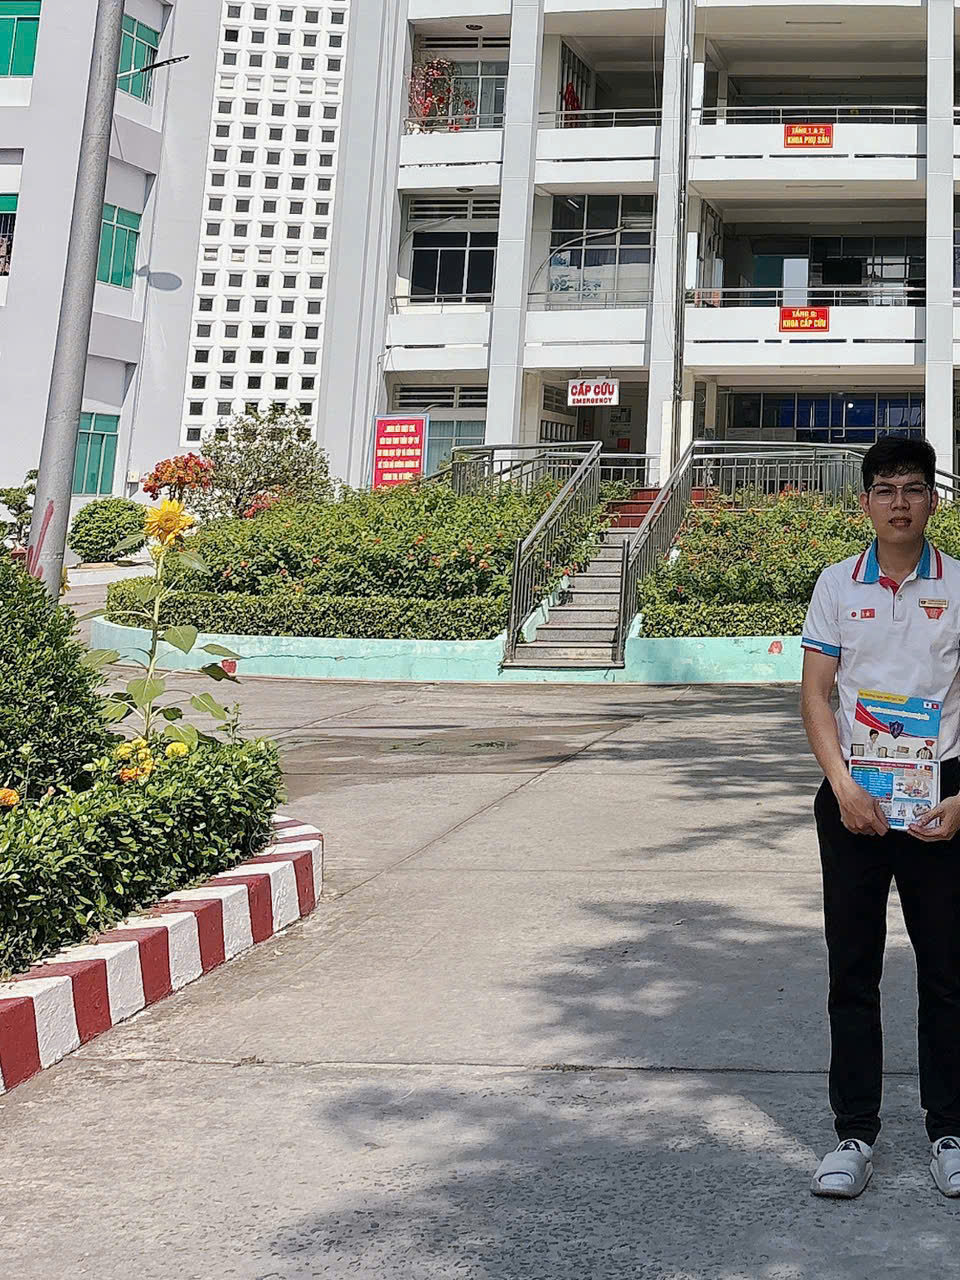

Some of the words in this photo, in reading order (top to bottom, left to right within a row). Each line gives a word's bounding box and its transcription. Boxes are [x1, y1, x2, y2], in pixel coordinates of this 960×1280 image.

[783, 320, 799, 328] KHOA
[800, 317, 813, 327] CẤP
[814, 318, 826, 327] CỨU
[570, 381, 591, 396] CẤP
[593, 382, 614, 396] CỨU
